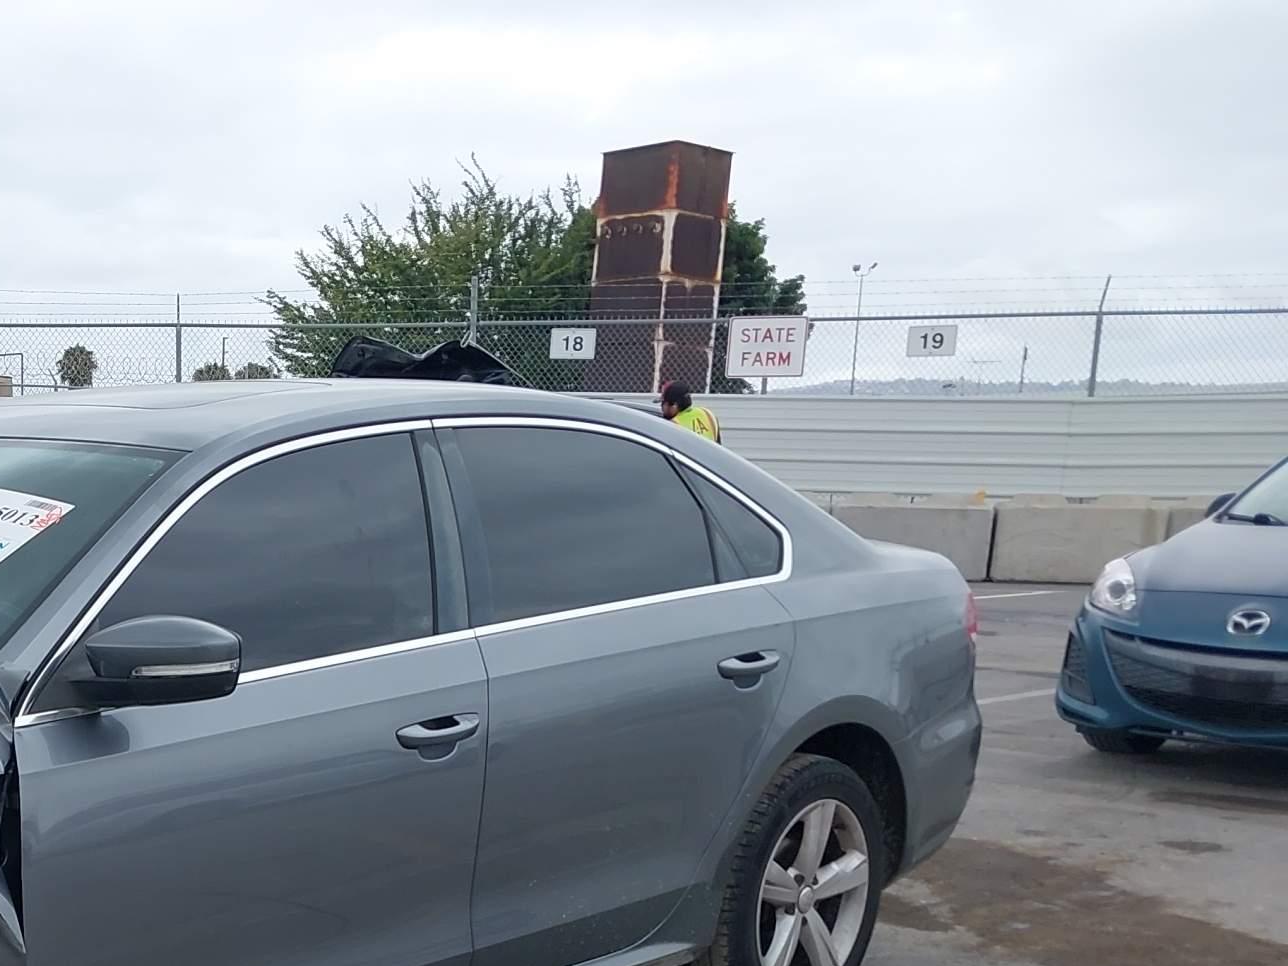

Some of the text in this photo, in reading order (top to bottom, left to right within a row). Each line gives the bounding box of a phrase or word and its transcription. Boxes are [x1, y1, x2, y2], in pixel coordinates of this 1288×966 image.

[561, 335, 584, 352] 18
[740, 327, 797, 344] STATE
[919, 333, 945, 350] 19
[740, 351, 792, 368] FARM
